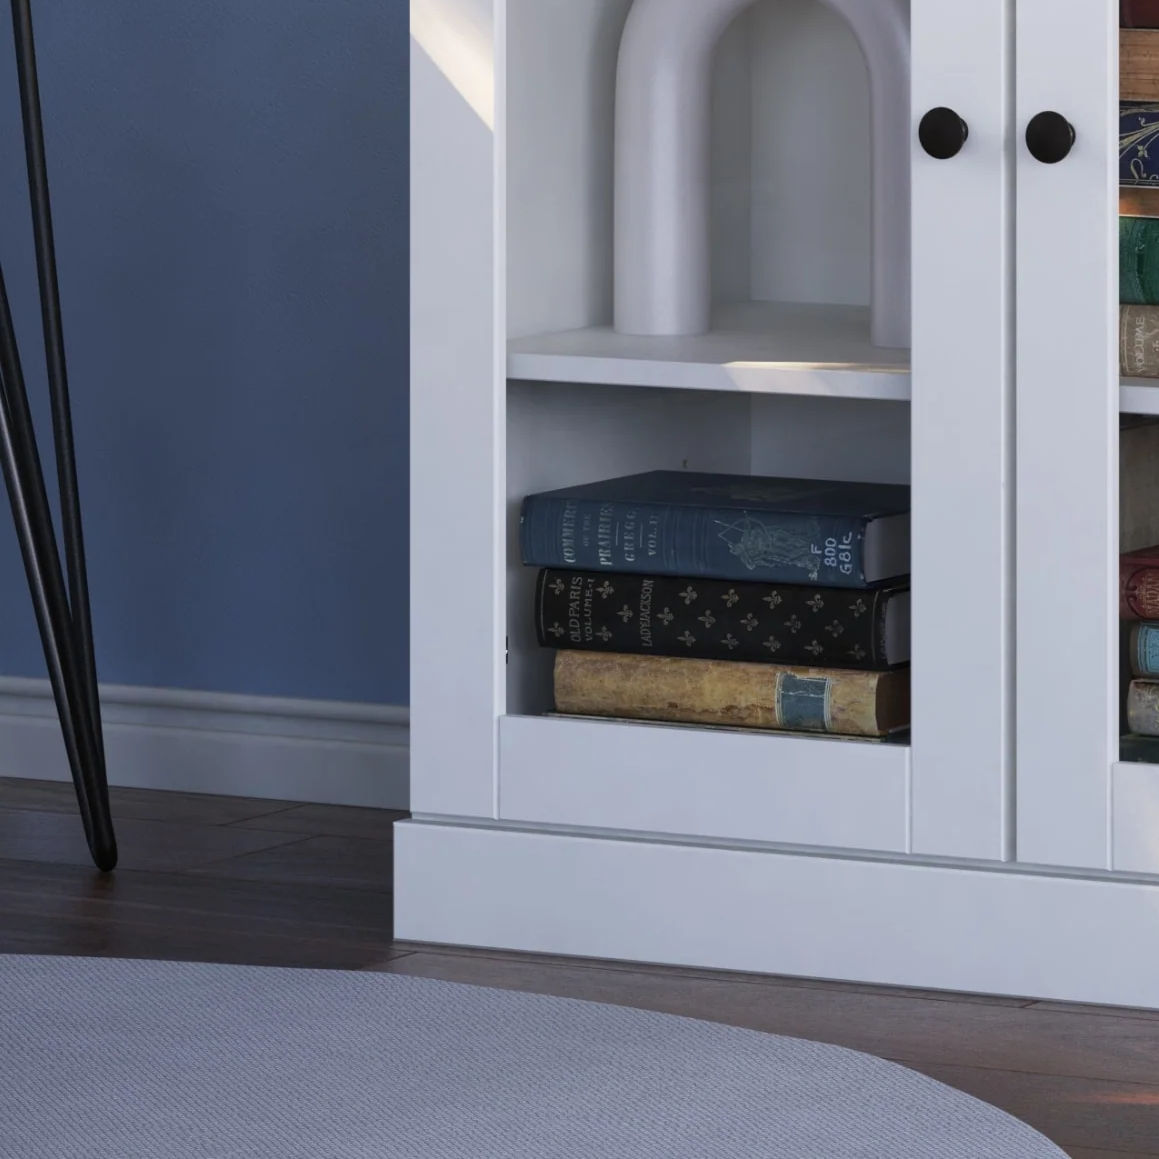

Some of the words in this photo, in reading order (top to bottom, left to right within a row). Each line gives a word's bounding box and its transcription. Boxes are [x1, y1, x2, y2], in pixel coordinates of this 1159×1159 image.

[1134, 316, 1145, 373] VOLUME
[811, 543, 822, 555] F
[568, 576, 583, 618] PARIS
[568, 619, 582, 642] OLD
